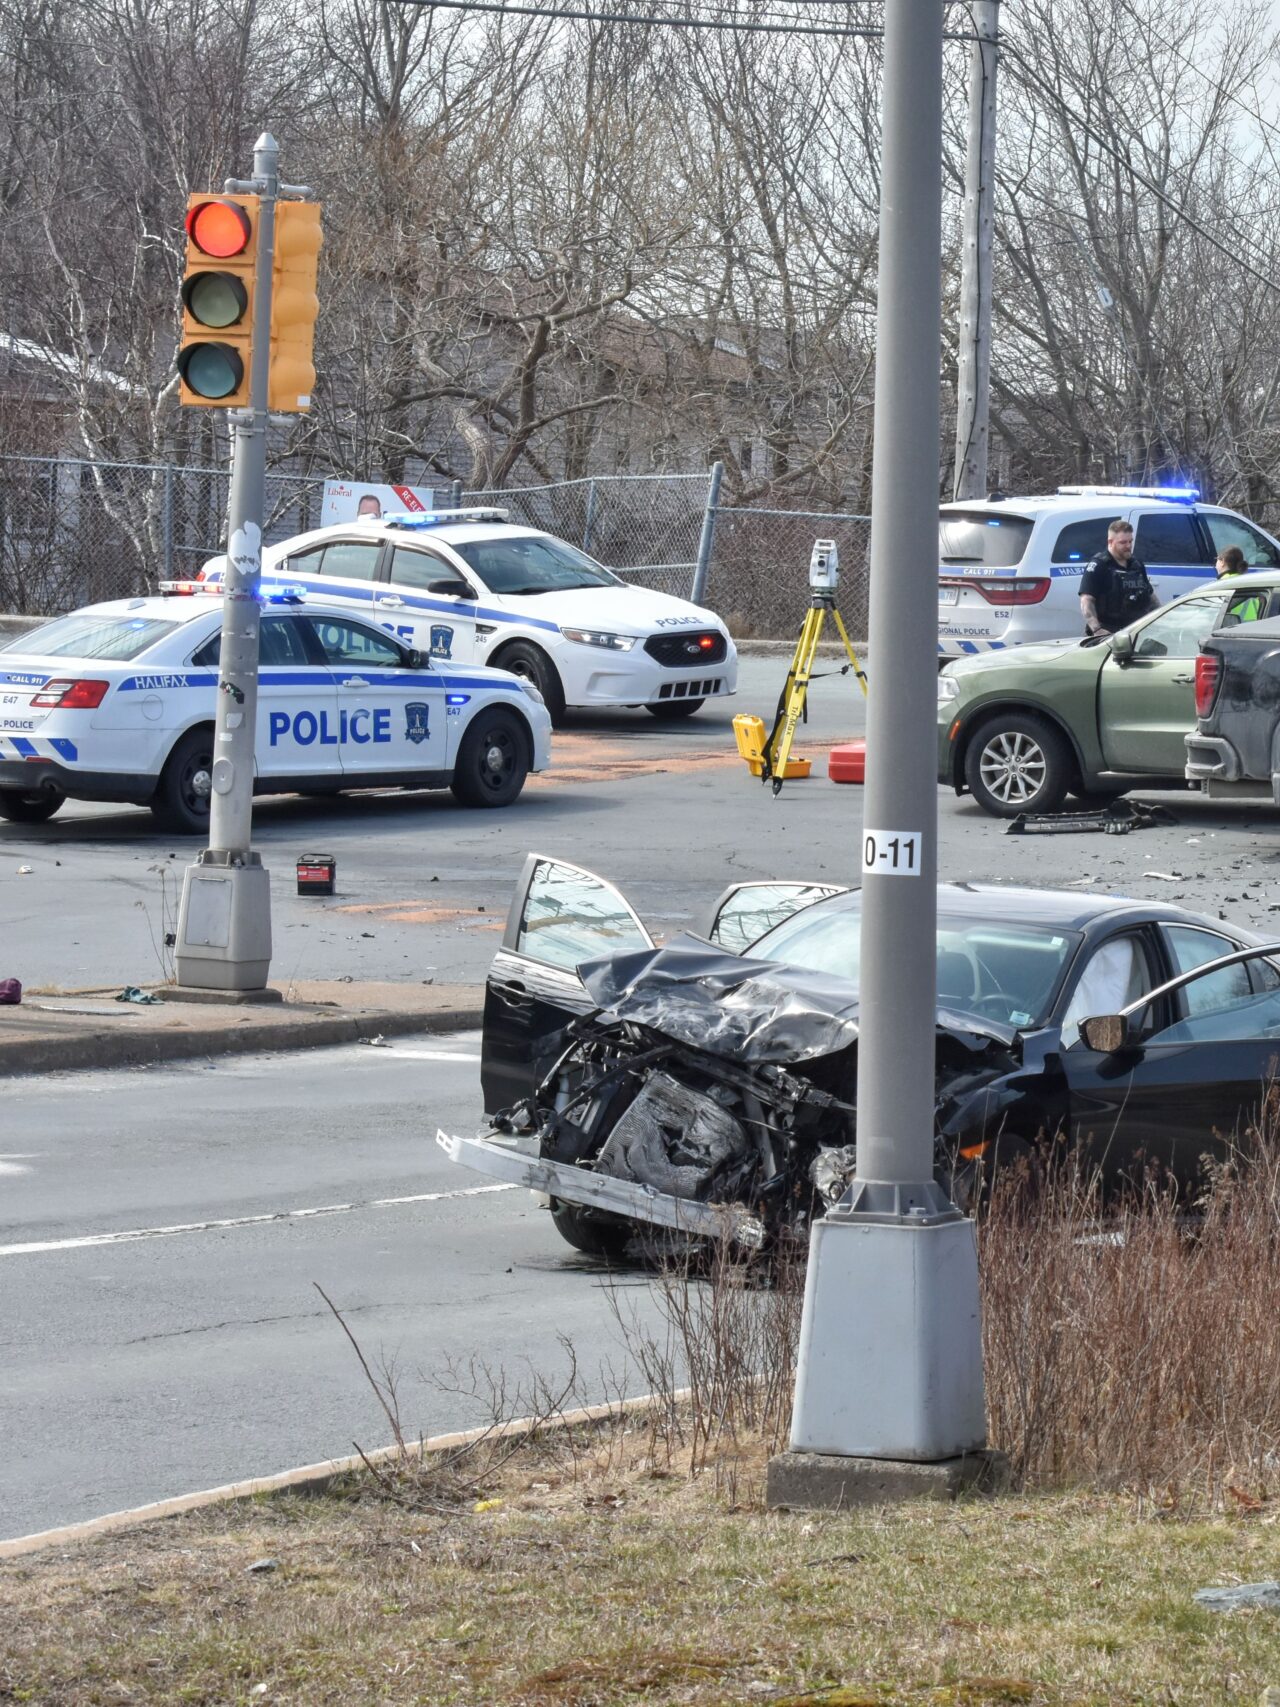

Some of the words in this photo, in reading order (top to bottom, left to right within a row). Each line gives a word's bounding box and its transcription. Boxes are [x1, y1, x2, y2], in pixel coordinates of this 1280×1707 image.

[327, 487, 352, 498] Liberal
[655, 616, 704, 627] POLICE
[475, 635, 488, 643] 245
[11, 675, 29, 683] CALL
[134, 675, 189, 689] HALIFAX
[3, 695, 19, 704] E47
[447, 707, 461, 716] E47
[3, 720, 34, 729] POLICE
[269, 708, 392, 747] POLICE
